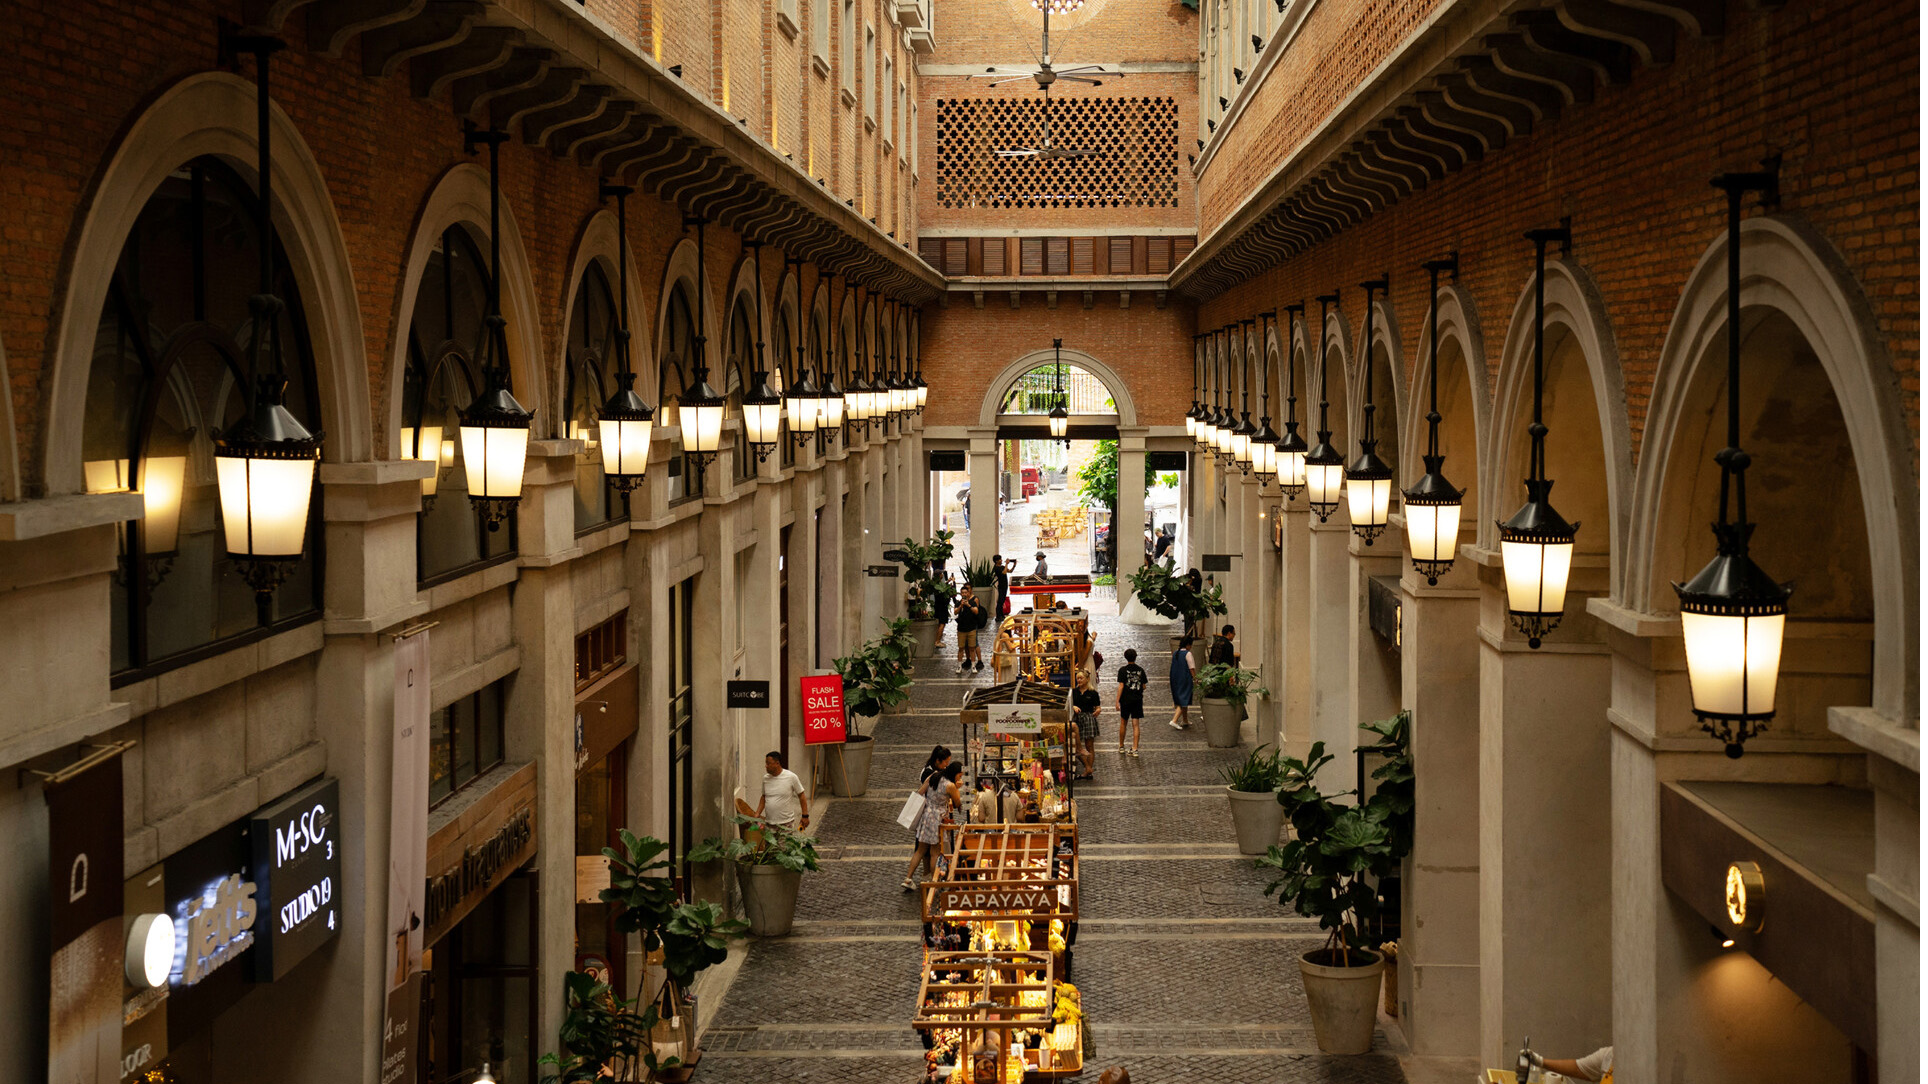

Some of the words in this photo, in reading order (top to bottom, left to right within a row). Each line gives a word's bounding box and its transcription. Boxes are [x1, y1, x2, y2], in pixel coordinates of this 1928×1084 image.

[811, 686, 835, 694] FLASH
[808, 696, 840, 709] SALE
[809, 717, 828, 729] -20
[830, 716, 842, 728] %
[276, 804, 326, 868] M-SC
[326, 840, 333, 860] 3
[462, 807, 531, 897] fragrances
[280, 884, 320, 934] STUDIO
[320, 876, 332, 906] 19
[947, 893, 1051, 908] PAPAYAYA
[327, 909, 335, 931] 4
[384, 1017, 393, 1042] 4
